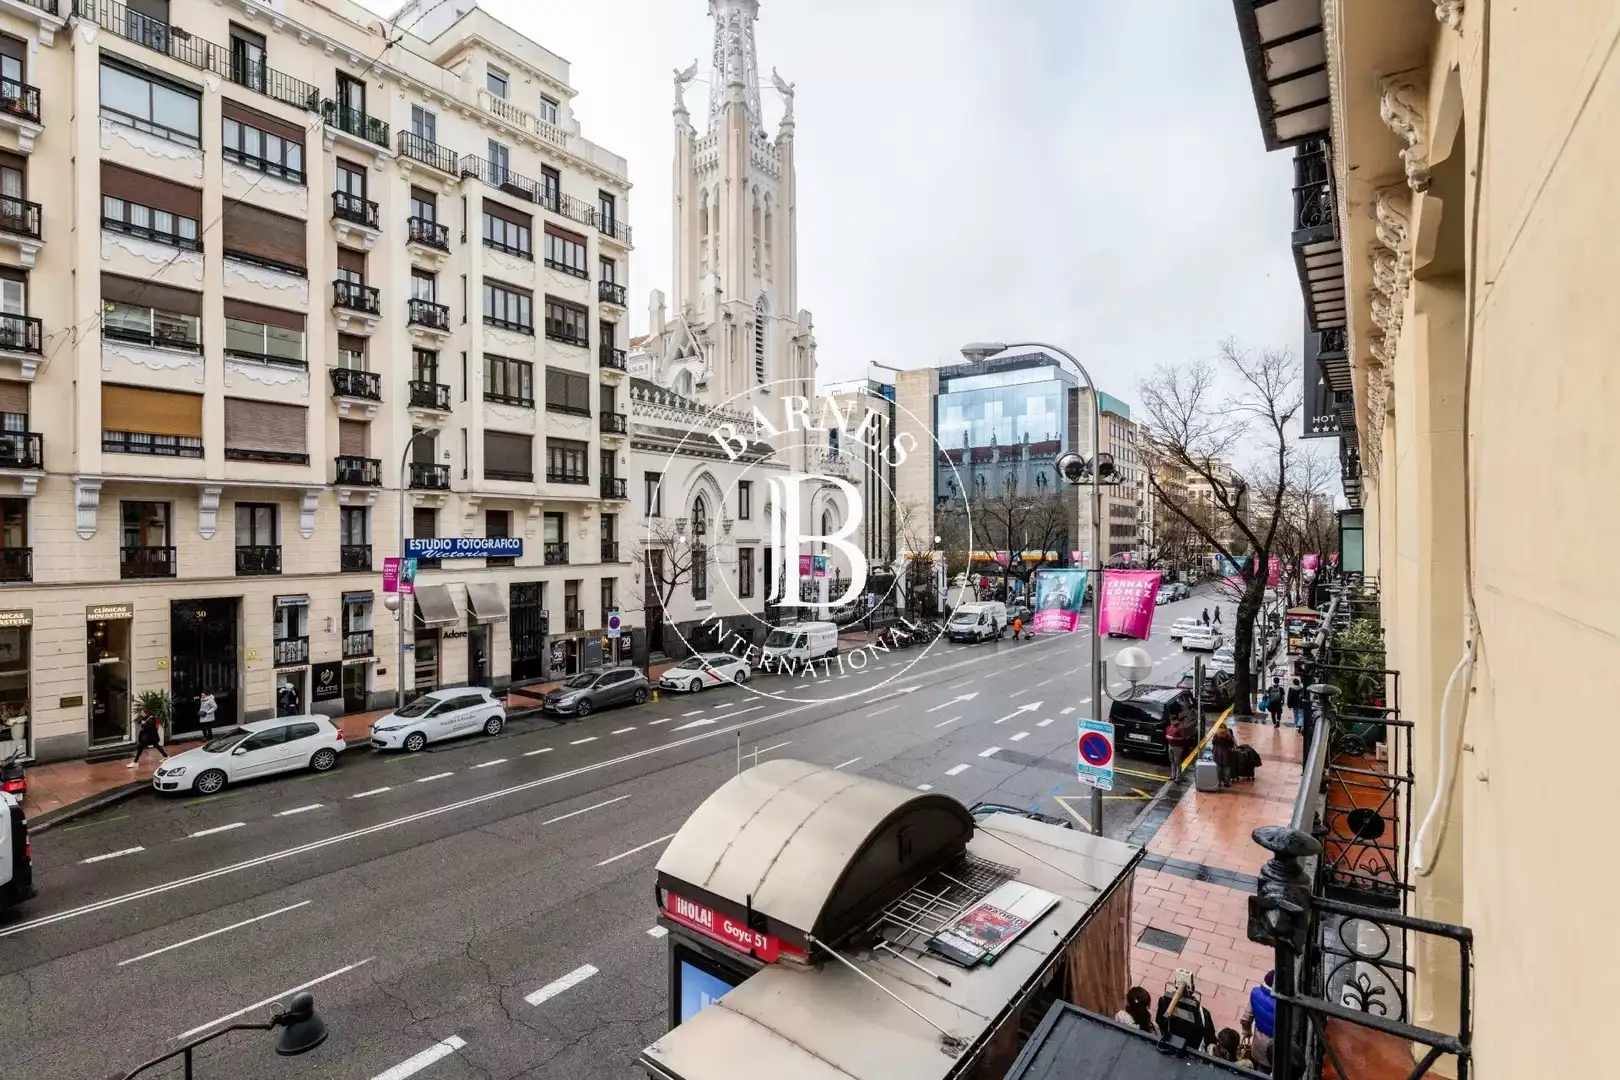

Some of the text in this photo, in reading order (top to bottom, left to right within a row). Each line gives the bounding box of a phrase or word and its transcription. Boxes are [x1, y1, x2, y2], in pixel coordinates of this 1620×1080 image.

[409, 538, 520, 550] ESTUDIO FOTOGRAFICO
[421, 549, 490, 558] Victoria
[87, 611, 132, 619] NOVASTETIC
[195, 610, 207, 619] 30
[443, 630, 468, 639] Adore
[677, 897, 768, 950] ¡HOLA! Goya 51
